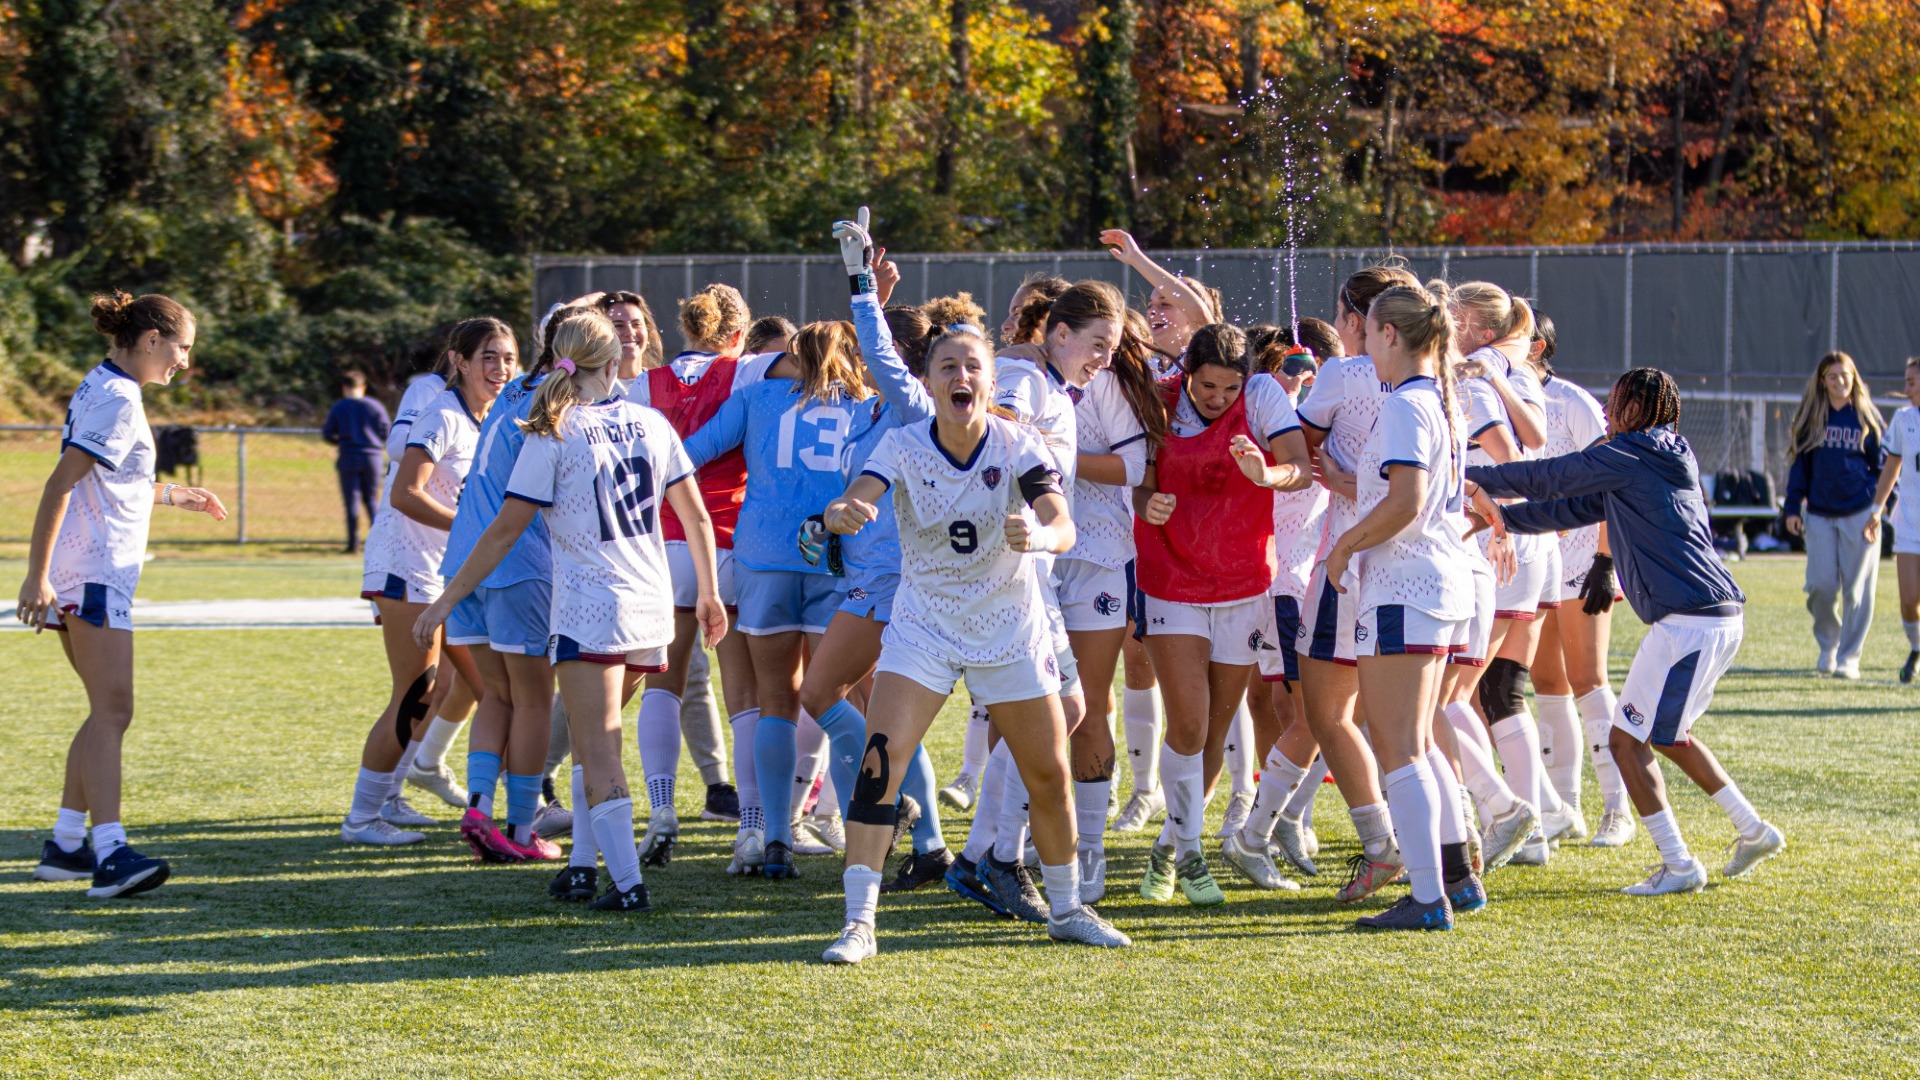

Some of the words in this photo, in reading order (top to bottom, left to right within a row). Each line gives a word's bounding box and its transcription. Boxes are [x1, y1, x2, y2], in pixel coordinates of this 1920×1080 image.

[583, 421, 646, 445] KNIGHTS
[776, 404, 852, 472] 13
[1826, 426, 1861, 442] DU
[593, 456, 655, 542] 12
[948, 519, 978, 554] 9
